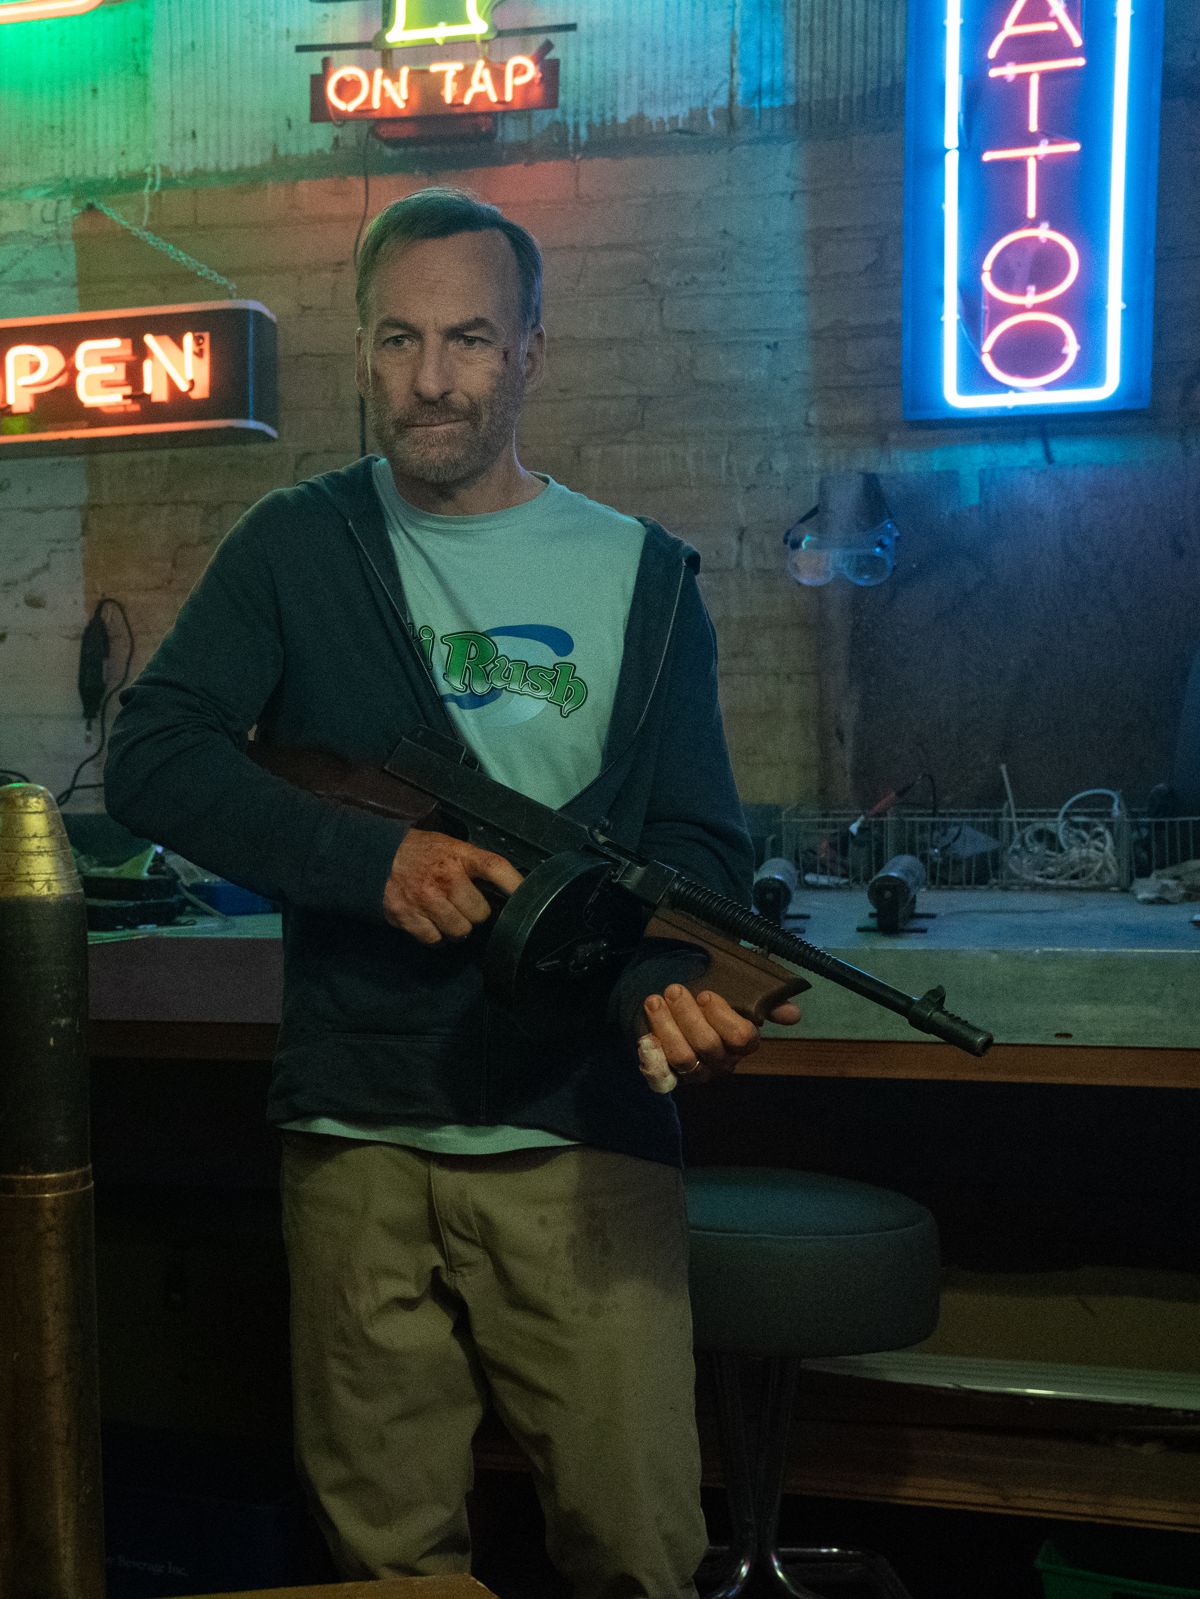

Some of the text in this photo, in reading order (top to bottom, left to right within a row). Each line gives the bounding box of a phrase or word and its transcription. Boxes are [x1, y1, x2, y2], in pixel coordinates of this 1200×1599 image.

[326, 55, 536, 112] ON TAP
[440, 631, 588, 718] Rush
